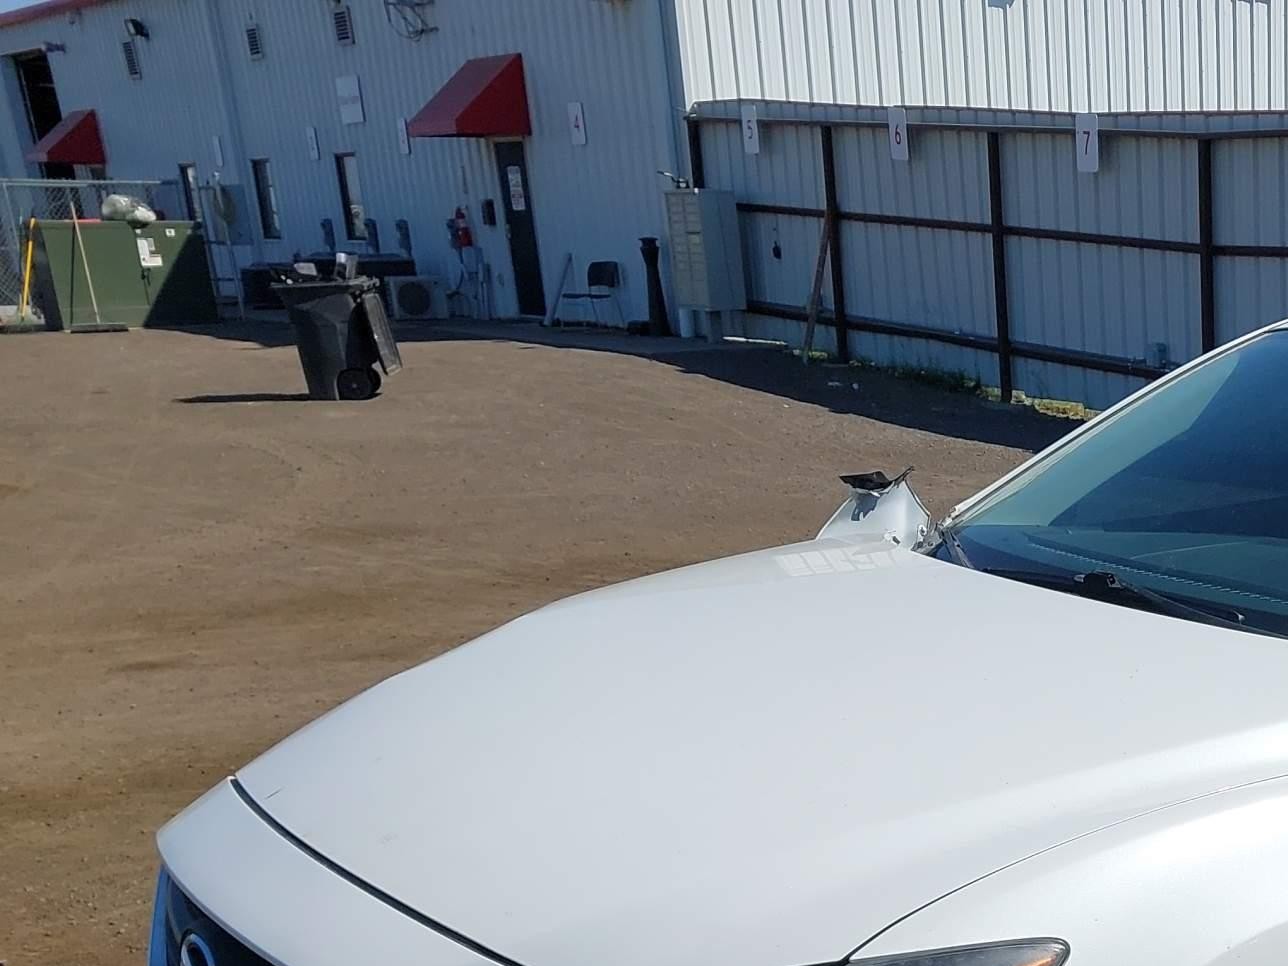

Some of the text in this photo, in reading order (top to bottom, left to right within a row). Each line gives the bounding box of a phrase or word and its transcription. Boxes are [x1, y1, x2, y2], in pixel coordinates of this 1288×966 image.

[746, 119, 754, 140] 5
[894, 123, 902, 145] 6
[1082, 130, 1091, 155] 7
